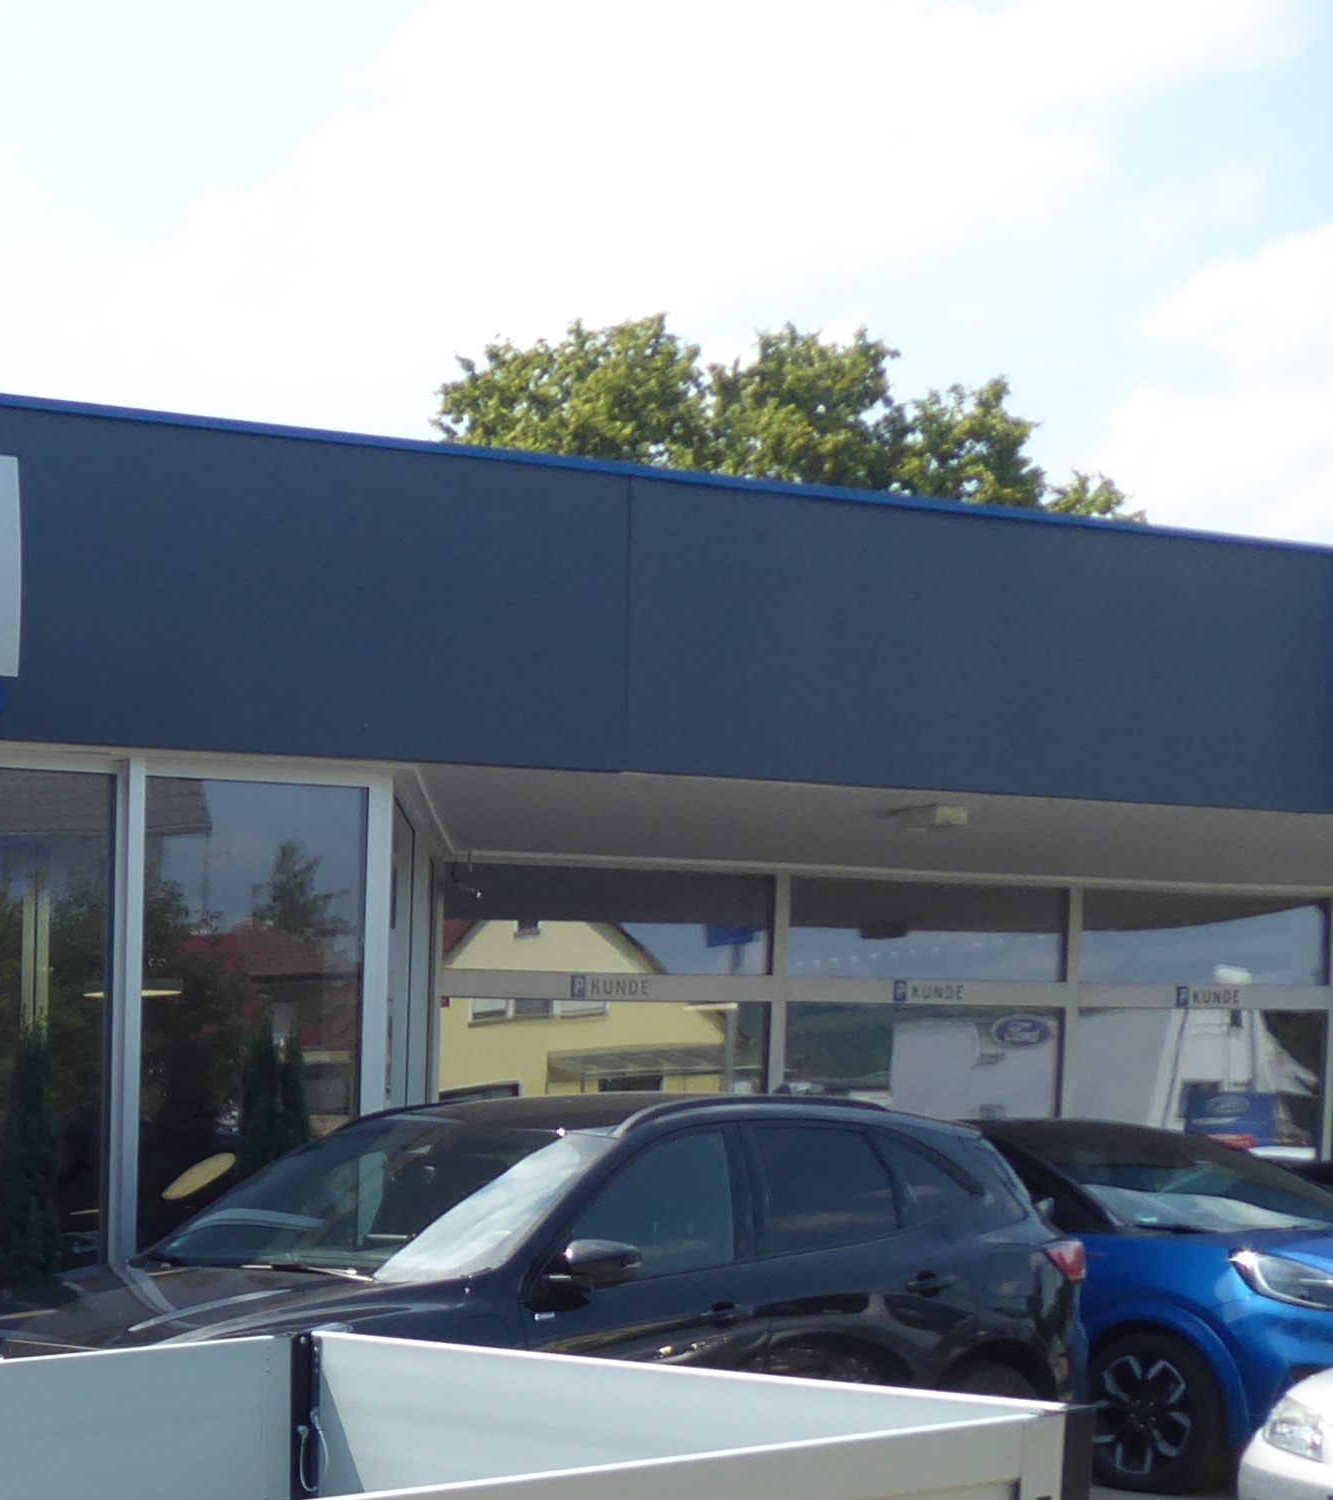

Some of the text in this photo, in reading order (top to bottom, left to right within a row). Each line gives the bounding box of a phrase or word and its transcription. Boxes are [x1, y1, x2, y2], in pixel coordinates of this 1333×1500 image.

[590, 978, 650, 996] KUNDE
[911, 984, 965, 1000] KUNDE
[1192, 988, 1241, 1005] KUNDE
